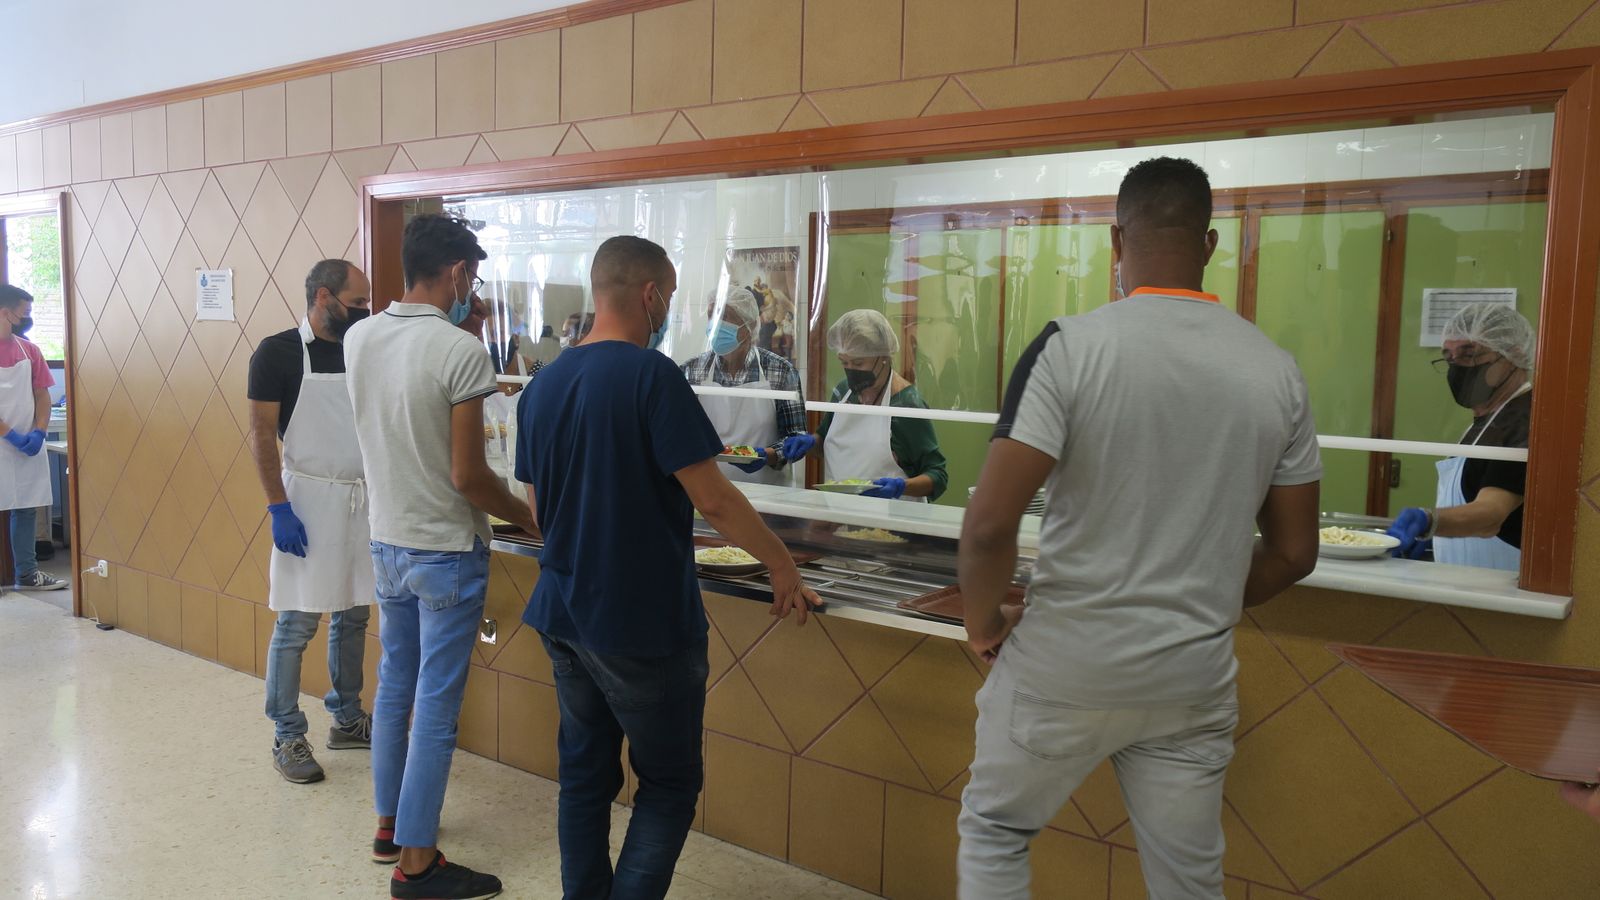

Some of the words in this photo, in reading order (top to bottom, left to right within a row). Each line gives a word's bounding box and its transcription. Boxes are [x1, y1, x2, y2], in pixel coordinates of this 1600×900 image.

[746, 251, 766, 264] JUAN
[767, 251, 778, 263] DE
[779, 250, 799, 265] DIOS
